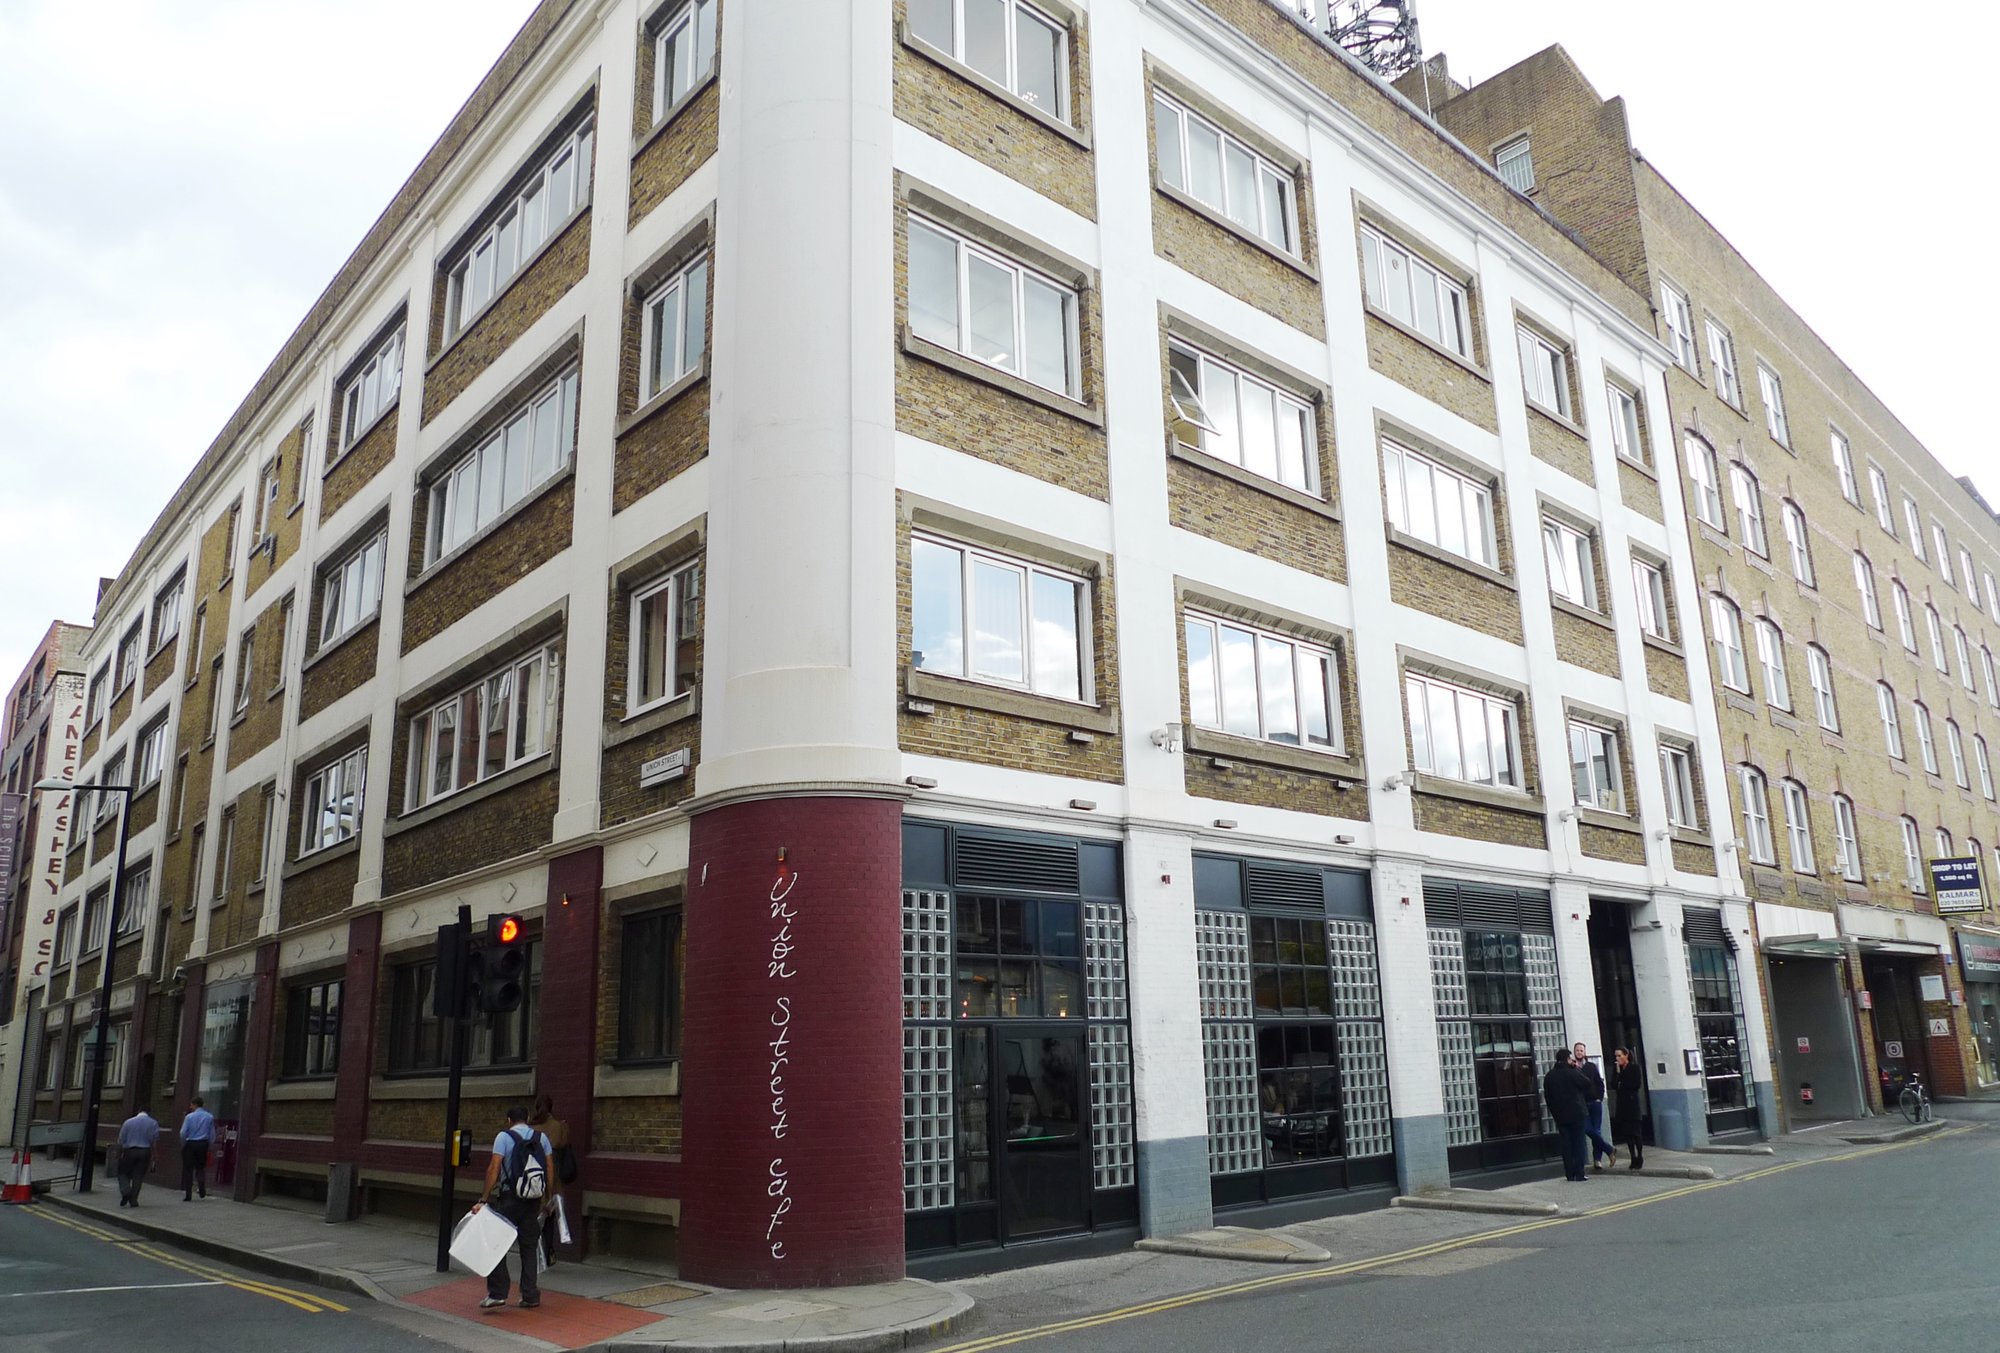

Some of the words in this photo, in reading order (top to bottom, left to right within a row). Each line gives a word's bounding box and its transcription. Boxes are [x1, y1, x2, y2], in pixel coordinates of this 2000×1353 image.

[646, 760, 660, 772] UNION
[661, 754, 678, 766] STREET
[2, 807, 17, 830] The
[1952, 863, 1963, 871] TO
[1963, 862, 1977, 870] LET
[768, 872, 798, 979] Union
[769, 997, 791, 1140] Street
[766, 1158, 792, 1259] cafe
